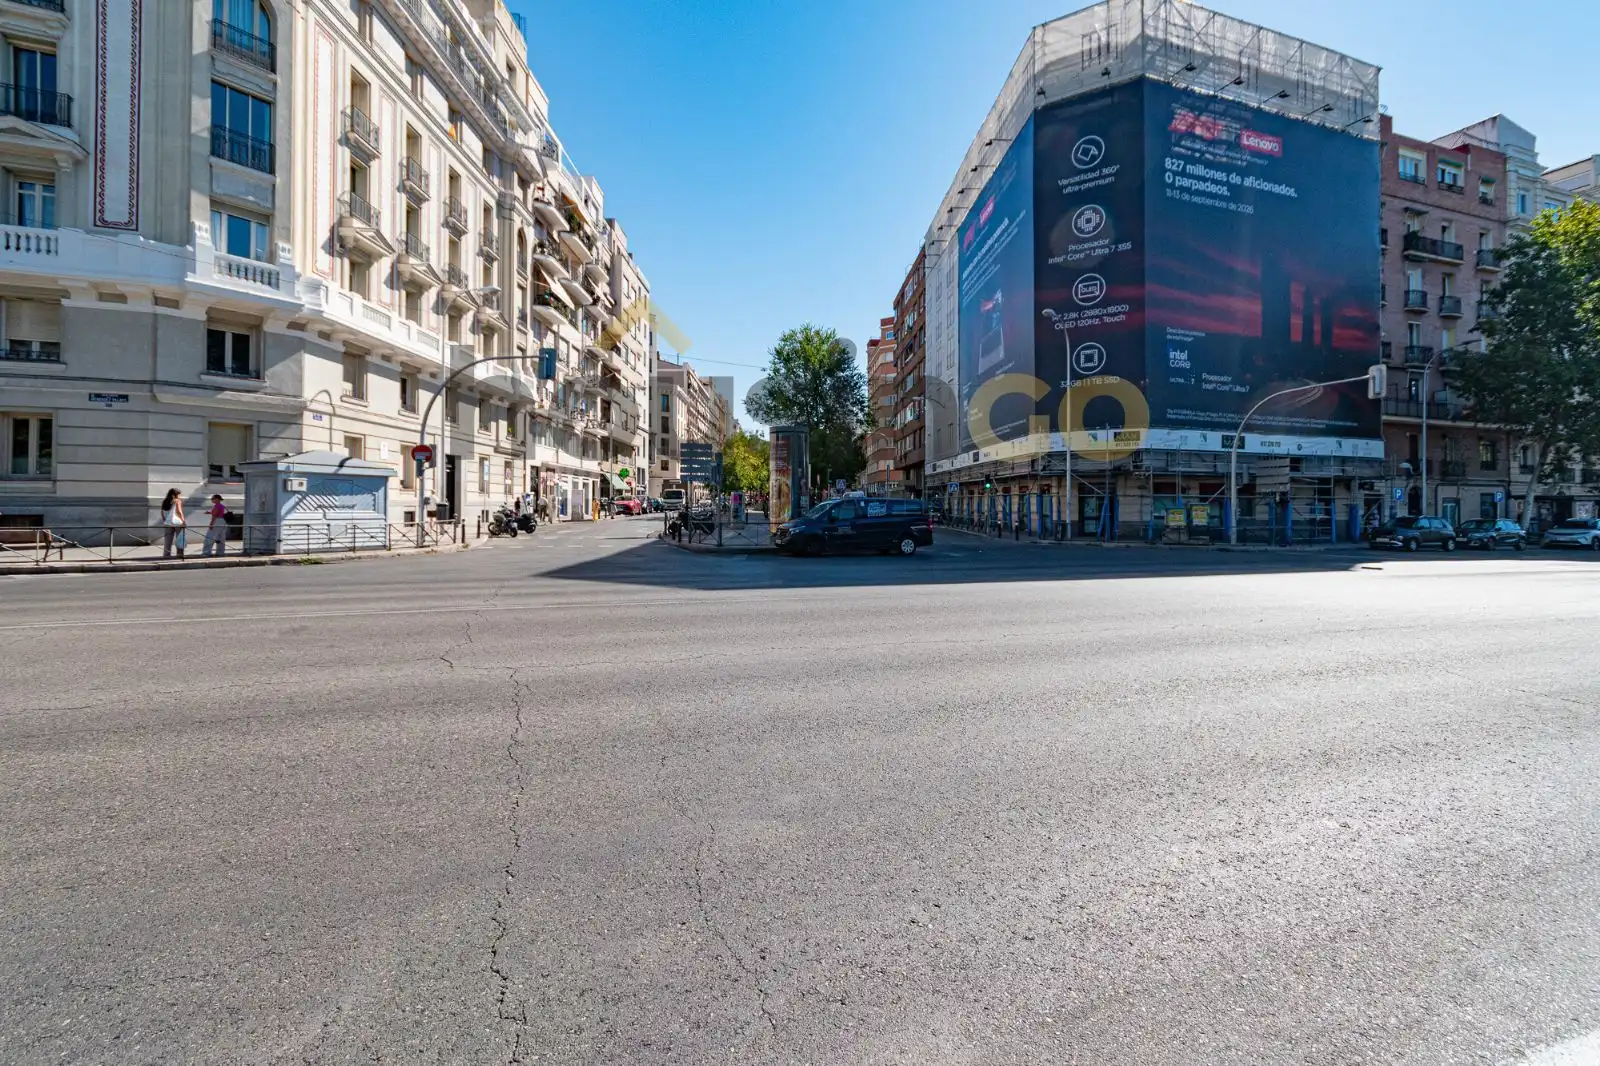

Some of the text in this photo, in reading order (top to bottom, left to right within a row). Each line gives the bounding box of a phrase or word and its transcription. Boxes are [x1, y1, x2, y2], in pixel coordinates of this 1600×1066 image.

[1243, 132, 1279, 152] Lenovo
[1058, 169, 1100, 186] Versatilidad
[1062, 176, 1115, 194] ultra-premium
[1165, 157, 1298, 198] 827 millones de aficionados.
[1165, 171, 1230, 196] 0 parpadeos.
[1181, 192, 1190, 201] de
[1190, 194, 1228, 209] septiembre
[1228, 202, 1236, 211] de
[1068, 238, 1110, 252] Procesador
[1091, 246, 1109, 256] Ultra
[1103, 314, 1126, 323] Touch
[1170, 349, 1188, 360] intel
